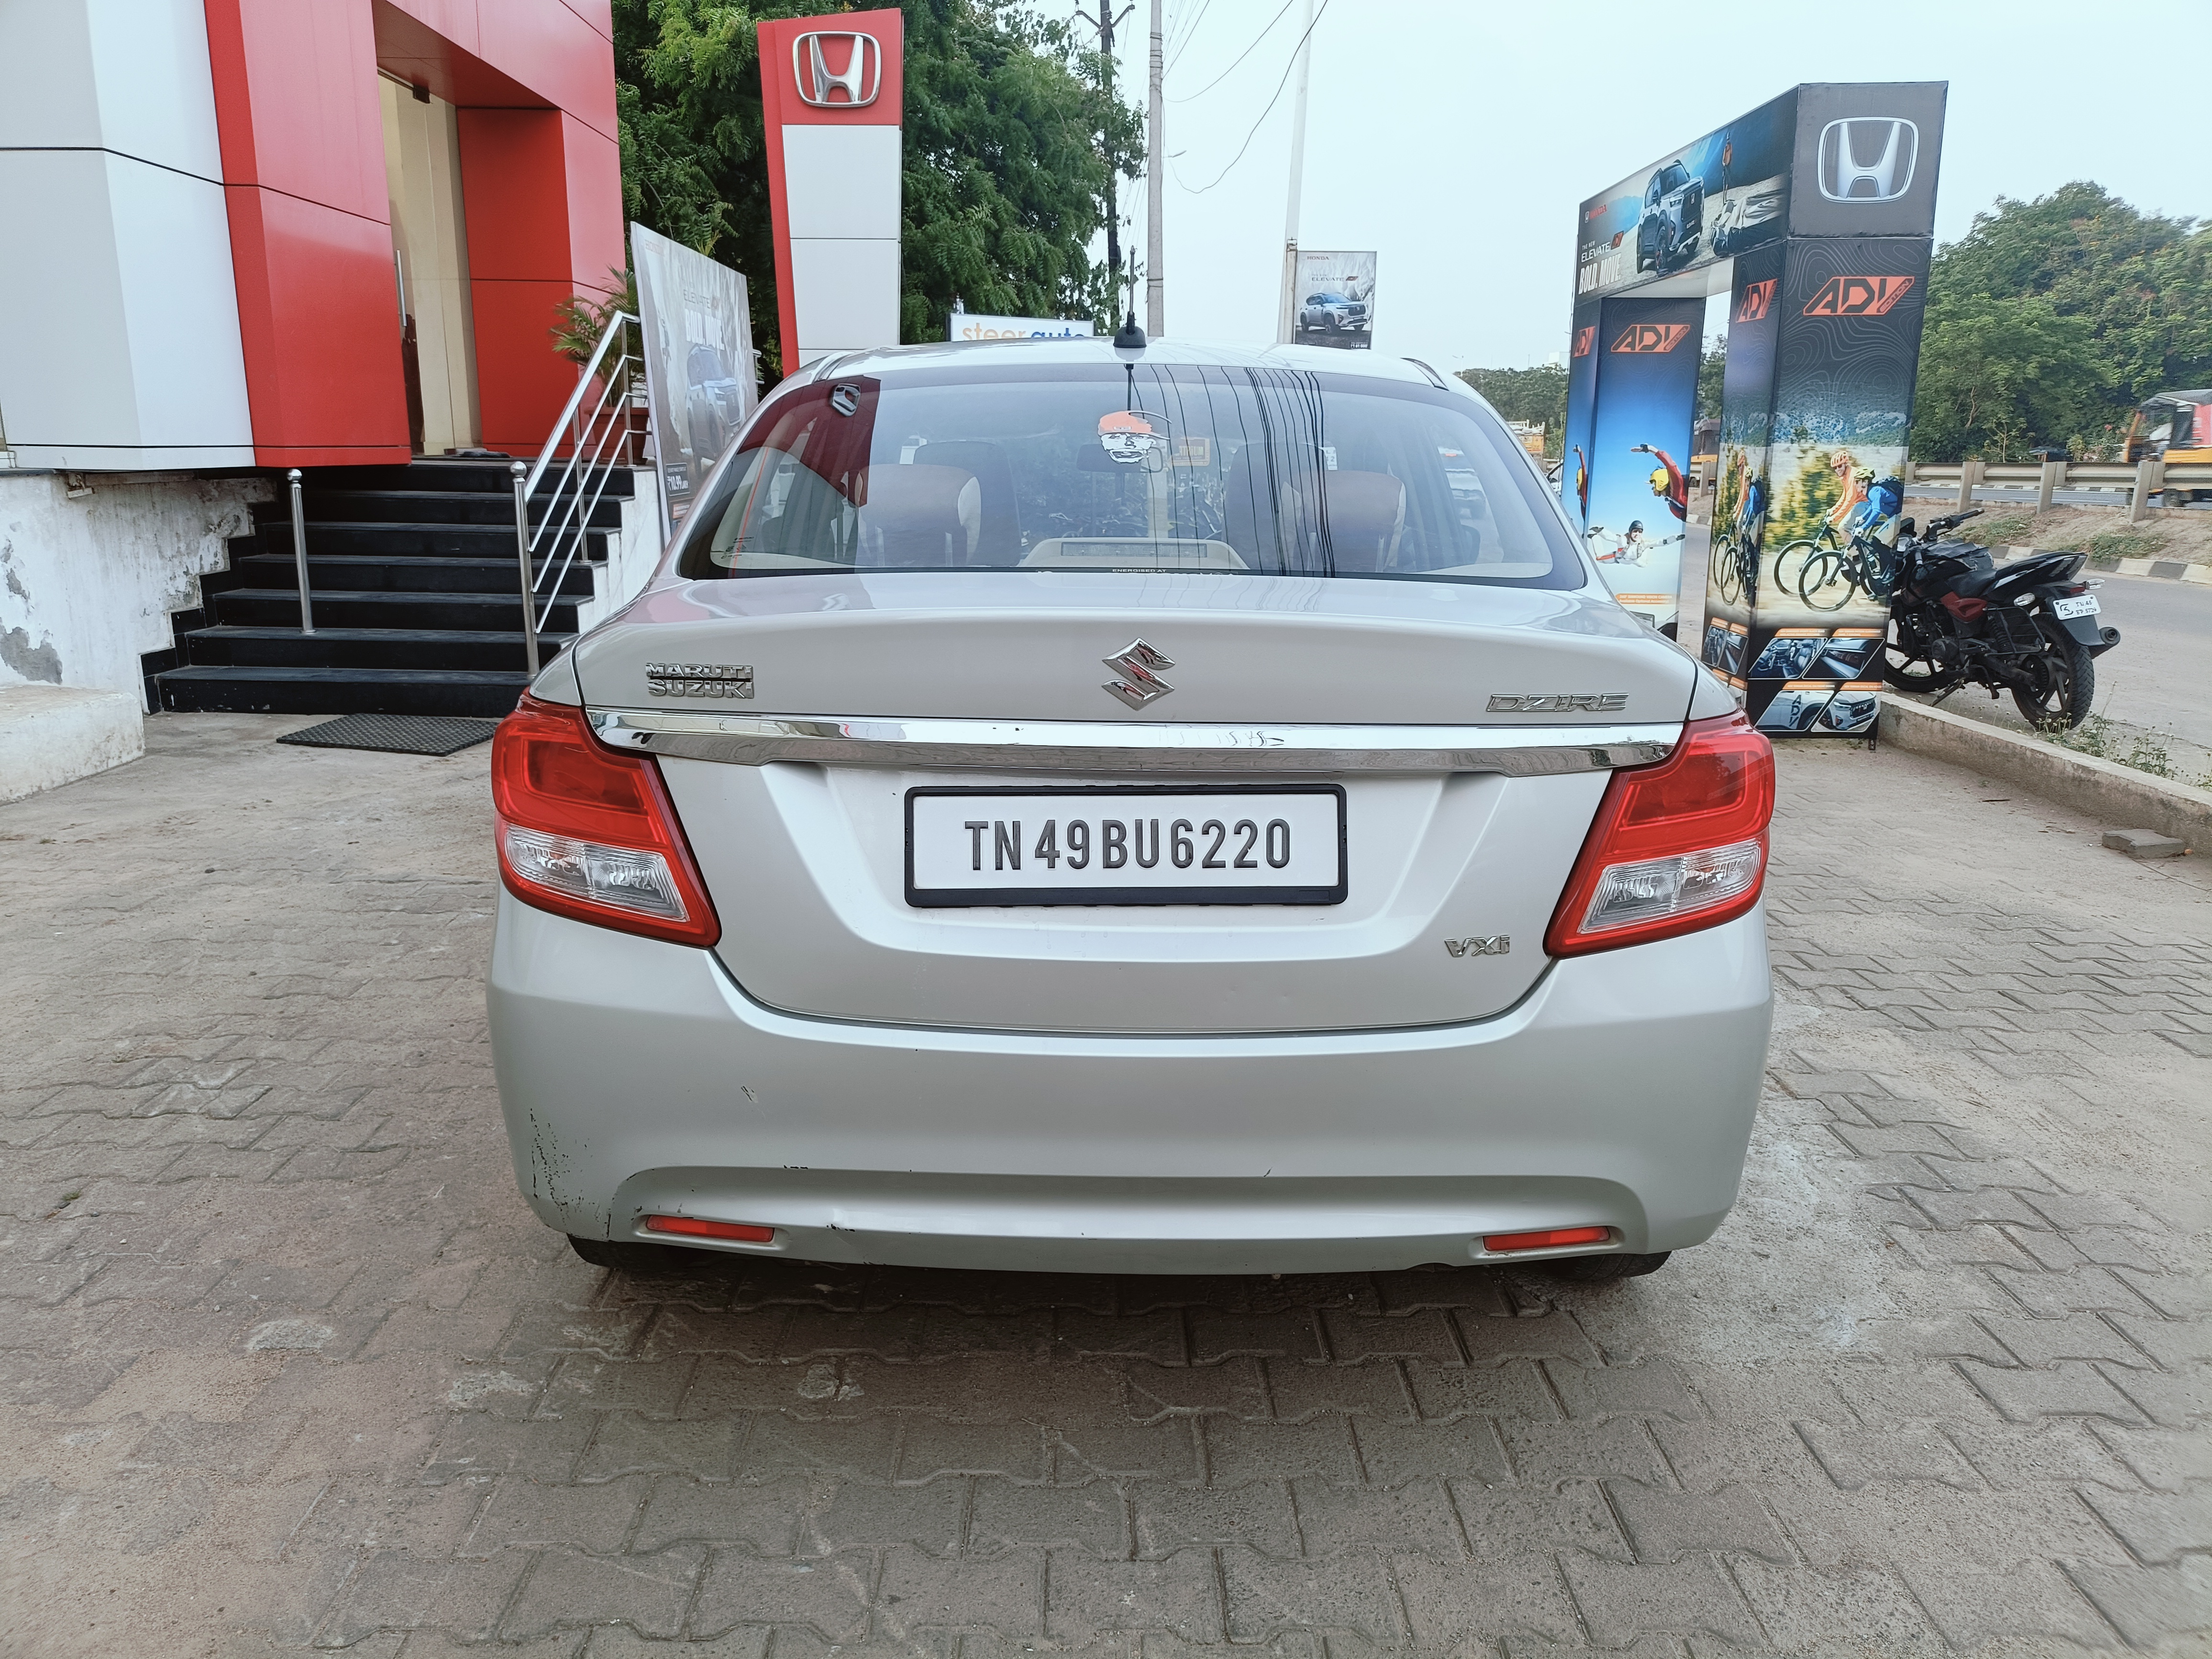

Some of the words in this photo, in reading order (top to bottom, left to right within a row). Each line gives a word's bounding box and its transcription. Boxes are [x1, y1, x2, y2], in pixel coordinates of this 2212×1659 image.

[1581, 242, 1610, 262] ELEVATE
[1579, 263, 1598, 294] BOLD.
[1599, 252, 1621, 287] MOVE.
[684, 289, 711, 309] ELEVATE
[1804, 276, 1914, 315] ADV
[646, 663, 753, 679] MARUTI
[647, 679, 754, 698] SUZUKI
[1486, 693, 1629, 712] DZIRE
